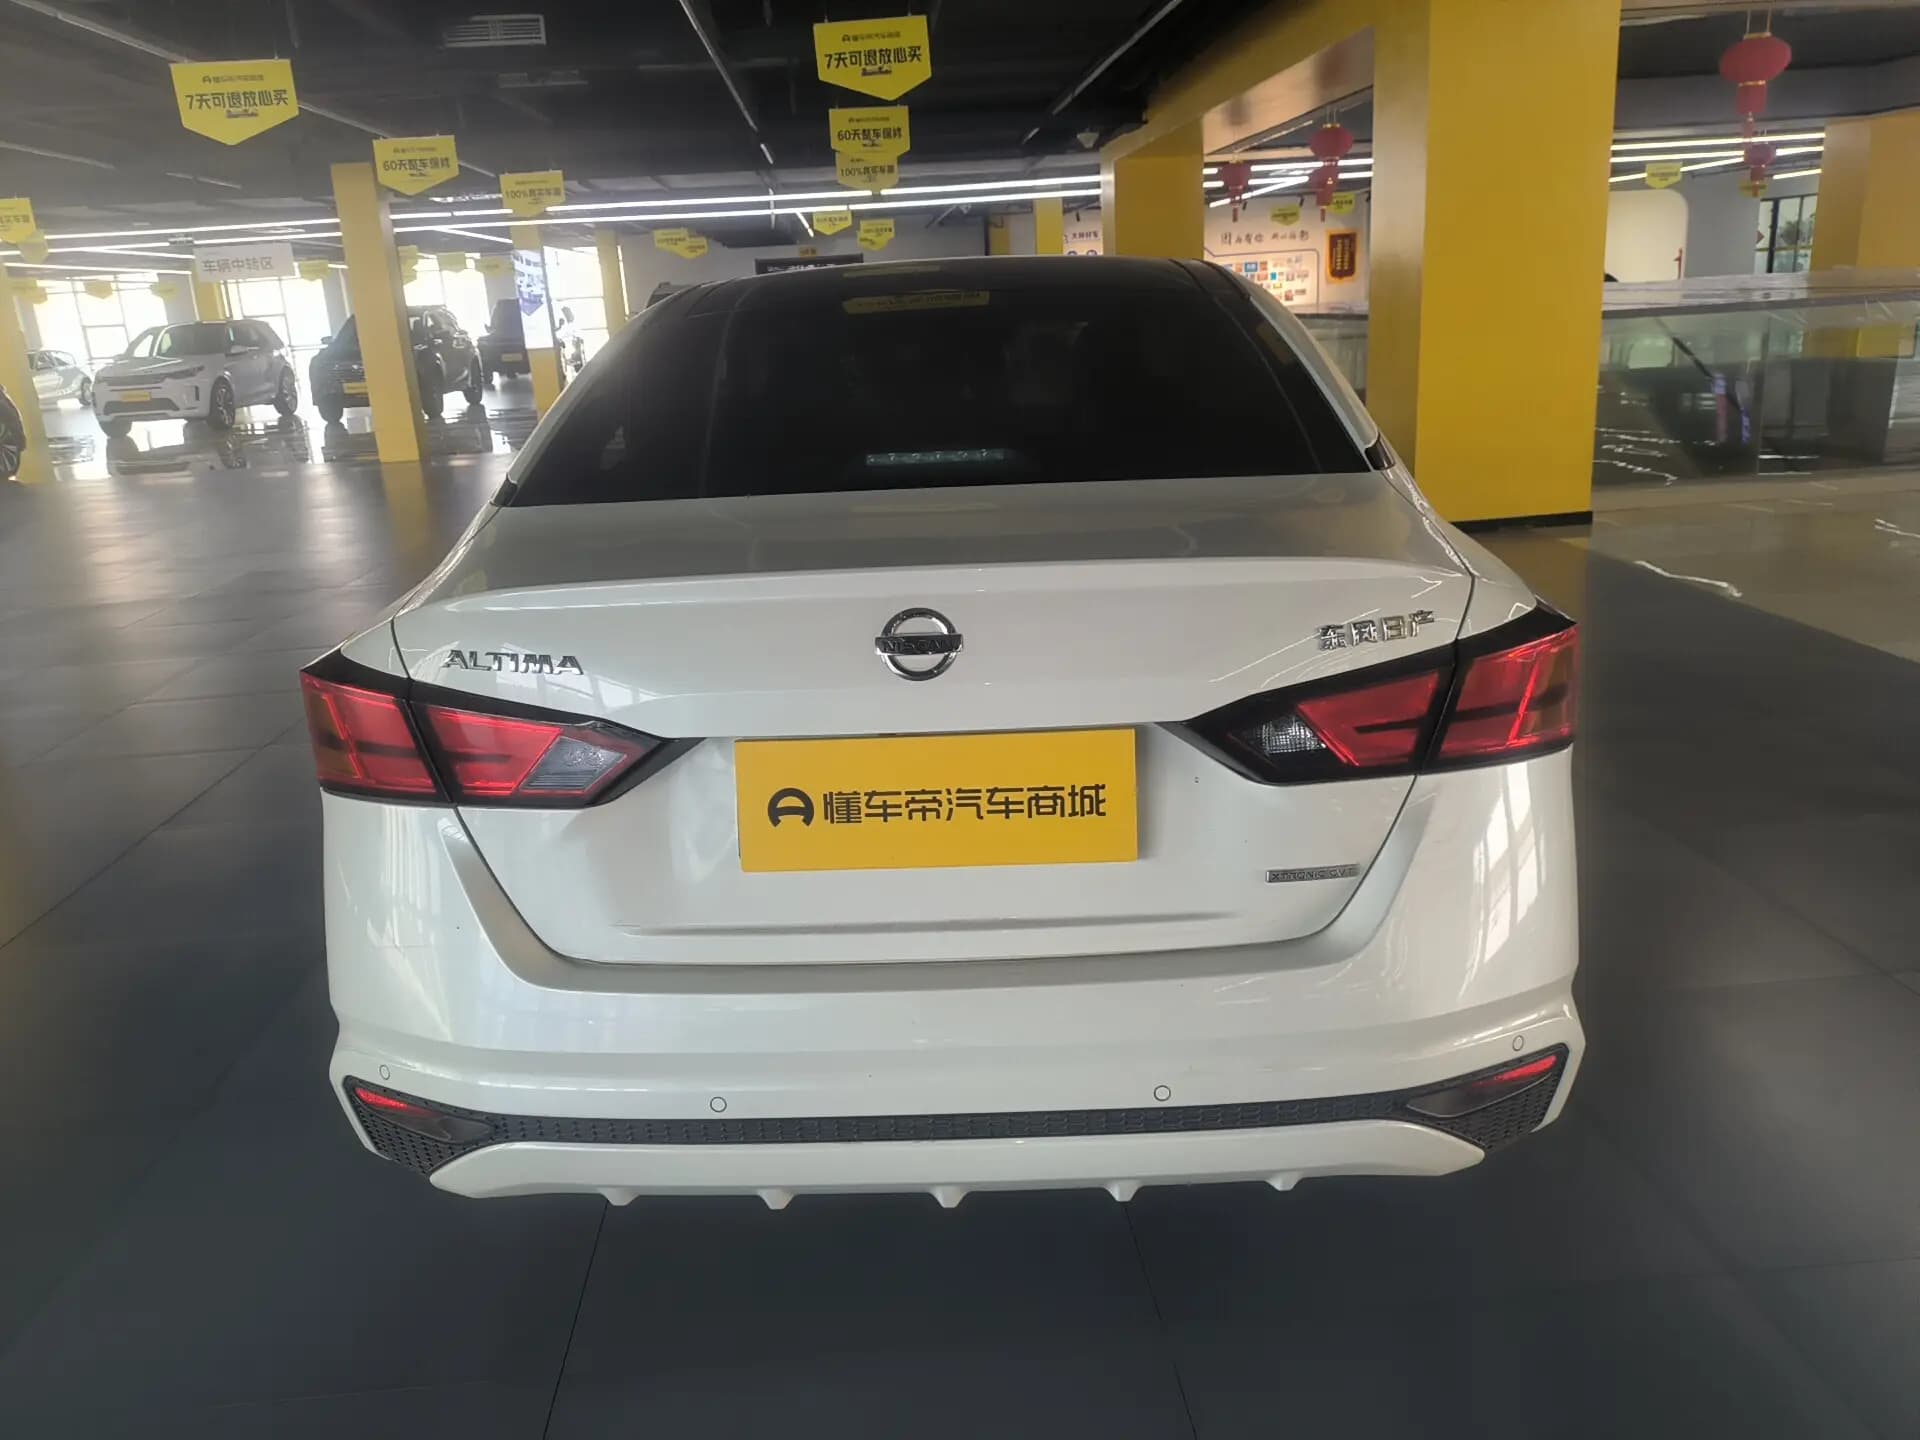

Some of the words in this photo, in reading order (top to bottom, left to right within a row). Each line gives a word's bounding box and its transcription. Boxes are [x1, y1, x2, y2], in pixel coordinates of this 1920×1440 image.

[823, 45, 923, 70] 7天可退放心买
[184, 89, 289, 110] 7天可退放心买
[202, 255, 273, 275] 车辆中转区
[1318, 609, 1435, 651] 东风日产
[441, 649, 585, 676] ALTIMA
[822, 783, 1107, 825] 懂车帝汽车商城
